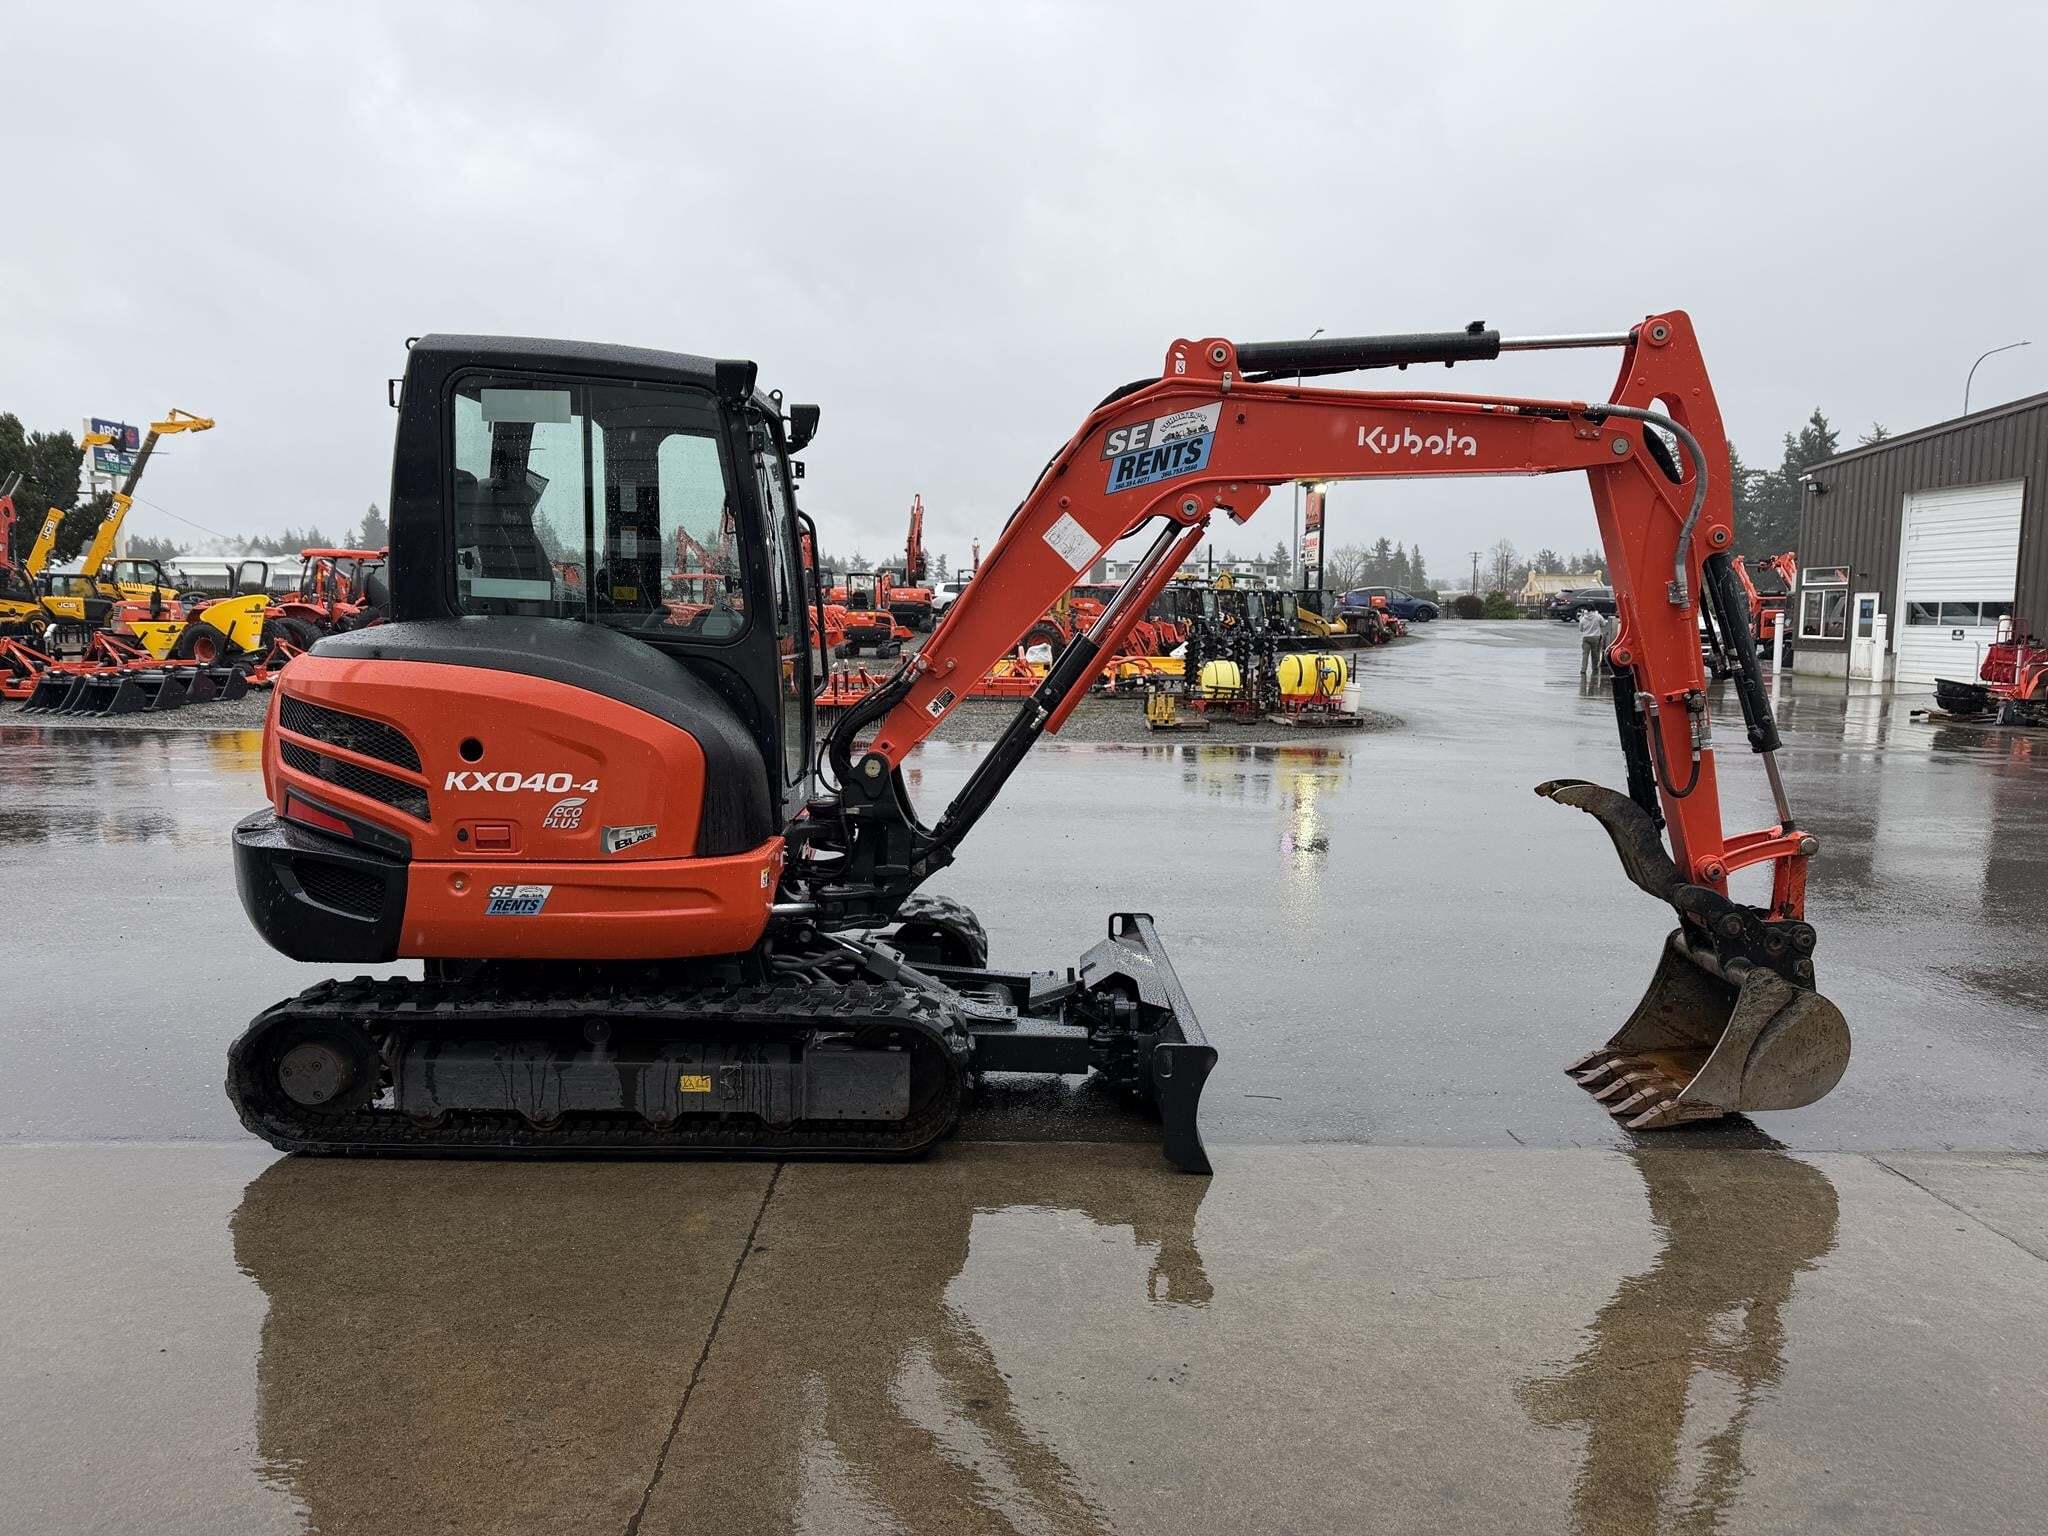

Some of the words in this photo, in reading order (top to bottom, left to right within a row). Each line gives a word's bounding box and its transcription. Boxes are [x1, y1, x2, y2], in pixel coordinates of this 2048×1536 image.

[1105, 423, 1149, 456] SE
[1357, 425, 1477, 456] Kubota
[1115, 438, 1204, 482] RENTS
[106, 501, 120, 521] JCB
[42, 520, 54, 539] JCB
[443, 771, 599, 793] KX040-4
[552, 805, 583, 818] eco
[542, 817, 581, 829] PLUS
[490, 886, 514, 897] SE
[491, 899, 540, 911] RENTS
